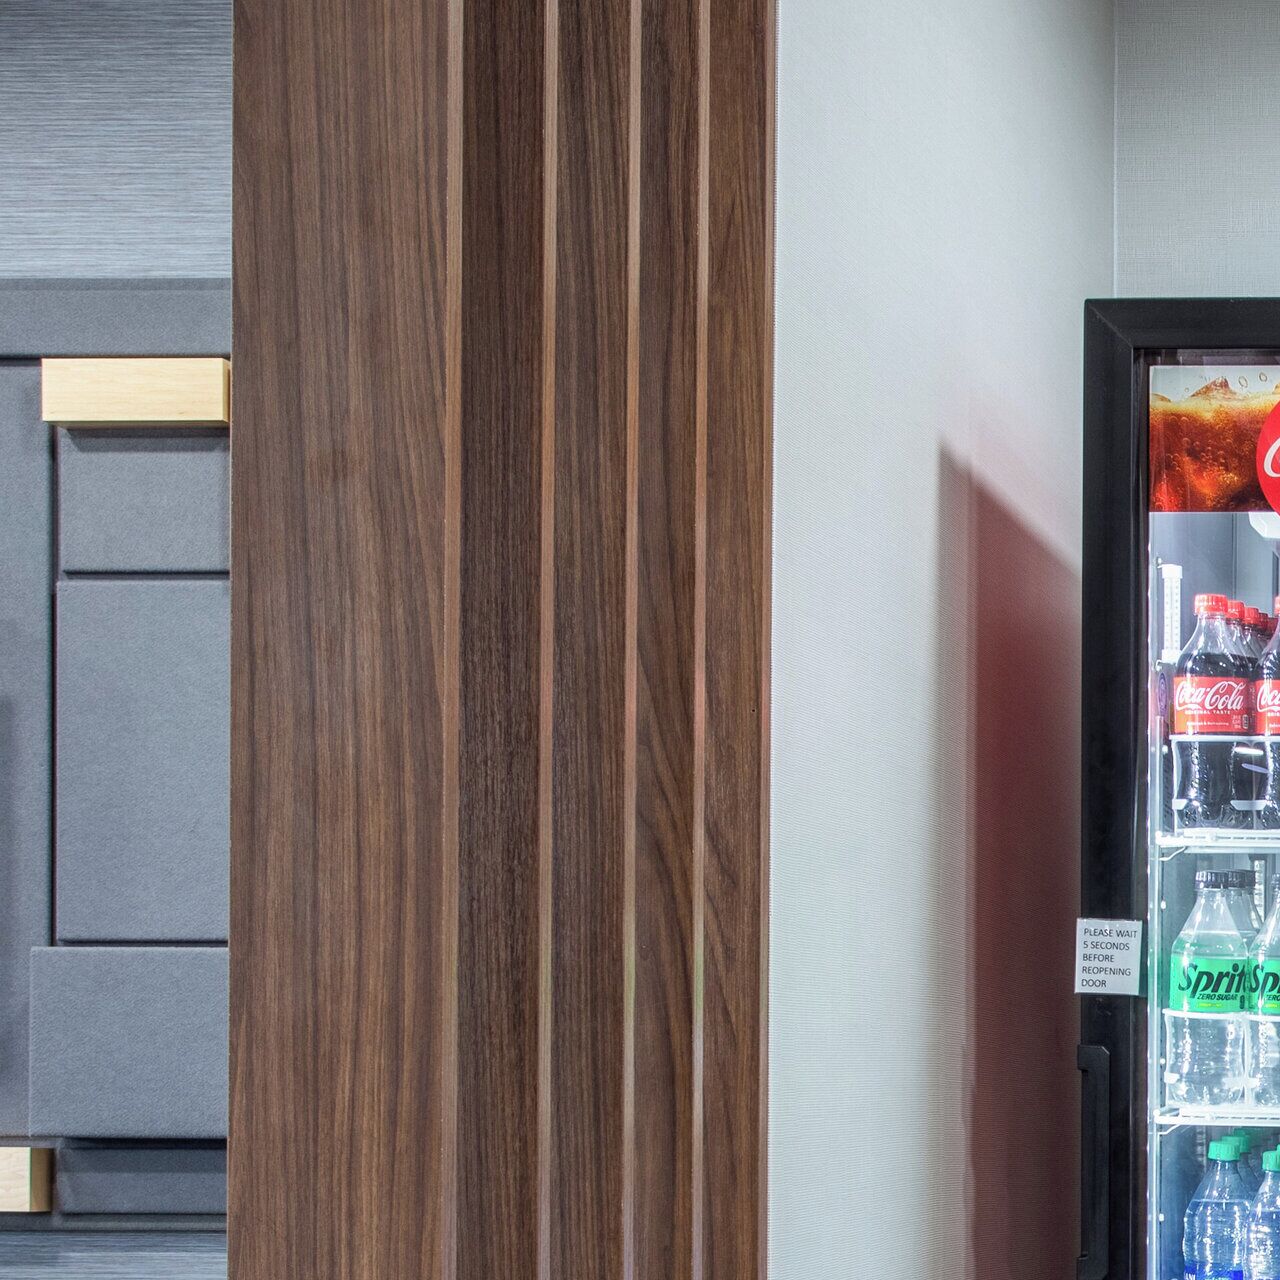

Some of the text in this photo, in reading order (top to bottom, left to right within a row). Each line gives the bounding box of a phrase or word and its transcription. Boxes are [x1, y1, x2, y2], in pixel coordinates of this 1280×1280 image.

[1176, 681, 1246, 711] Coca-Cola
[1084, 928, 1137, 938] PLEASE WAIT
[1083, 941, 1130, 950] 5 SECONDS
[1083, 954, 1115, 962] BEFORE
[1082, 966, 1131, 976] REOPENING
[1081, 979, 1107, 987] DOOR
[1178, 963, 1247, 999] Sprit
